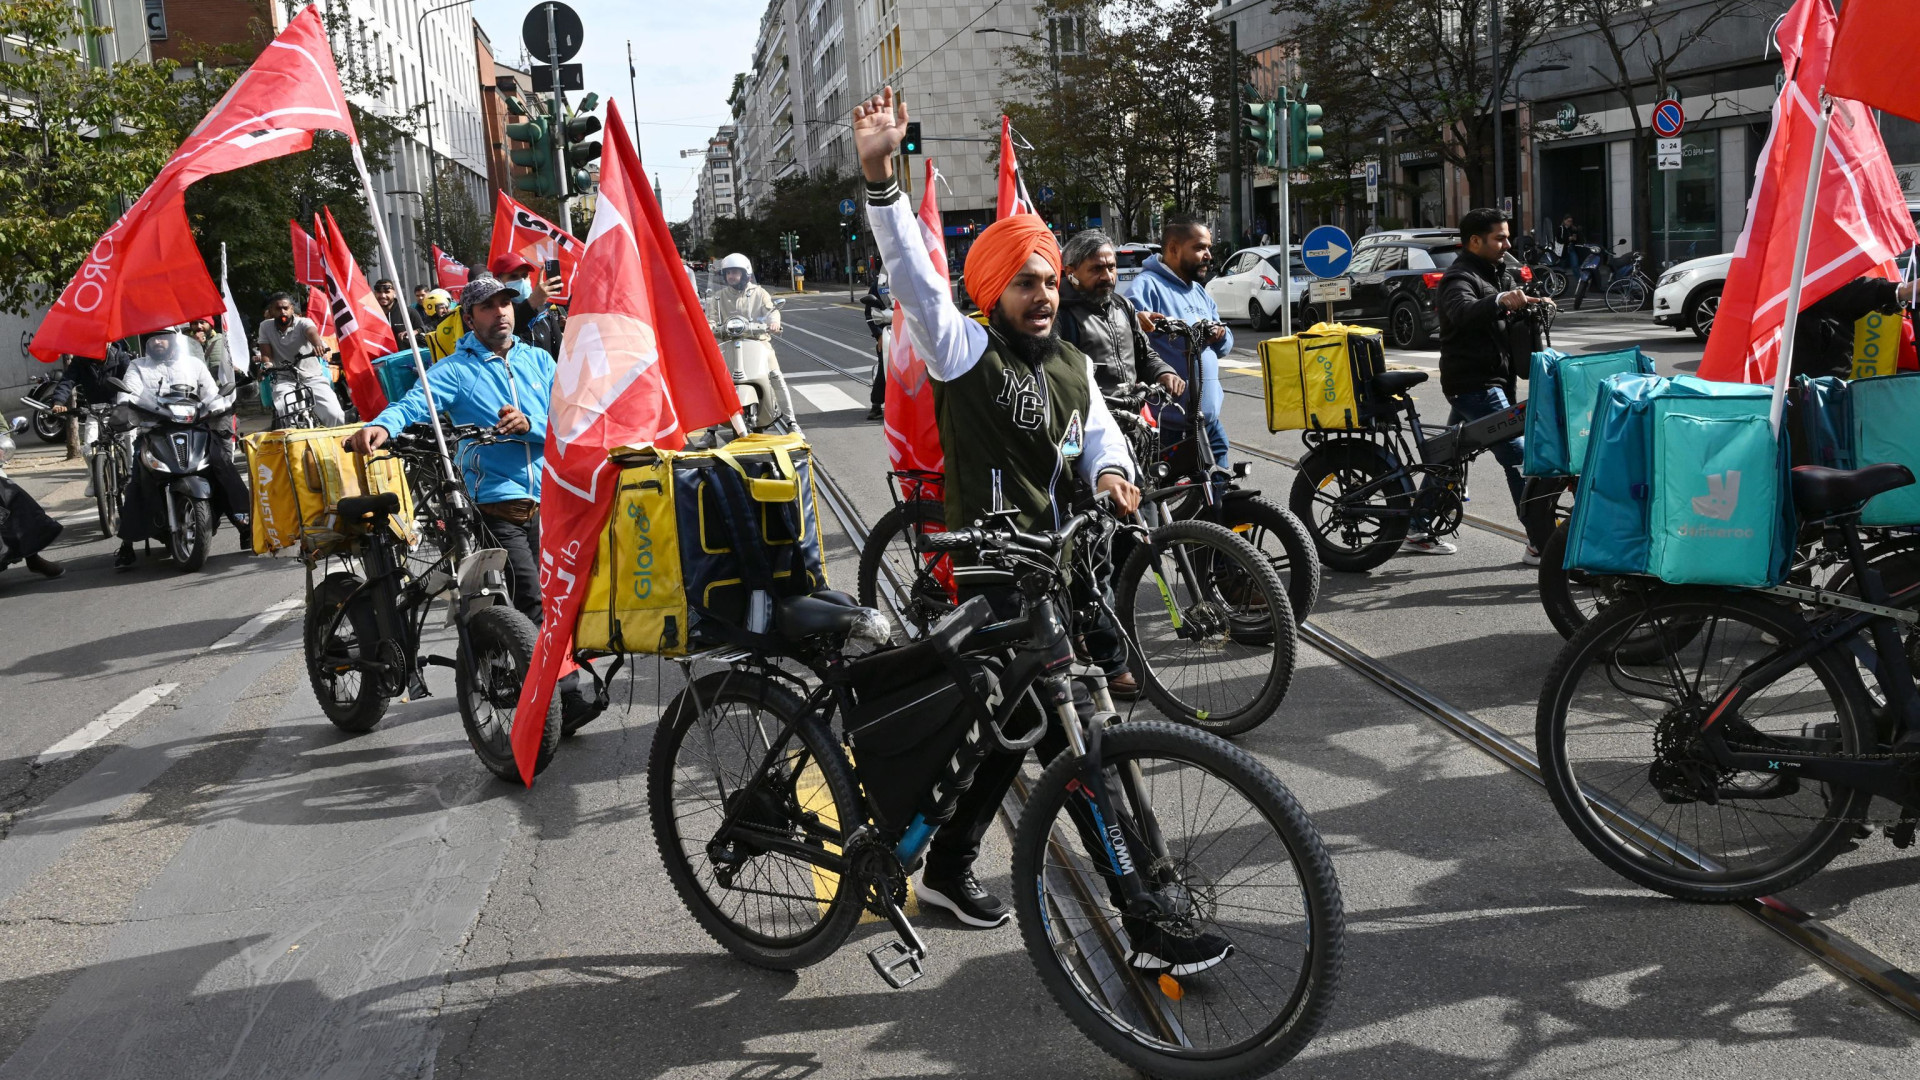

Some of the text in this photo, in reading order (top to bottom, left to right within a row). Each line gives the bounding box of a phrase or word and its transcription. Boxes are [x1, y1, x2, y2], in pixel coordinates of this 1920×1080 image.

[1368, 167, 1375, 183] P
[1856, 313, 1882, 378] Glovo
[1323, 360, 1336, 402] Glovo
[258, 489, 284, 549] JUST EA
[1678, 522, 1755, 539] deliveroo
[633, 515, 654, 599] Glovo
[1107, 822, 1135, 876] 100MM
